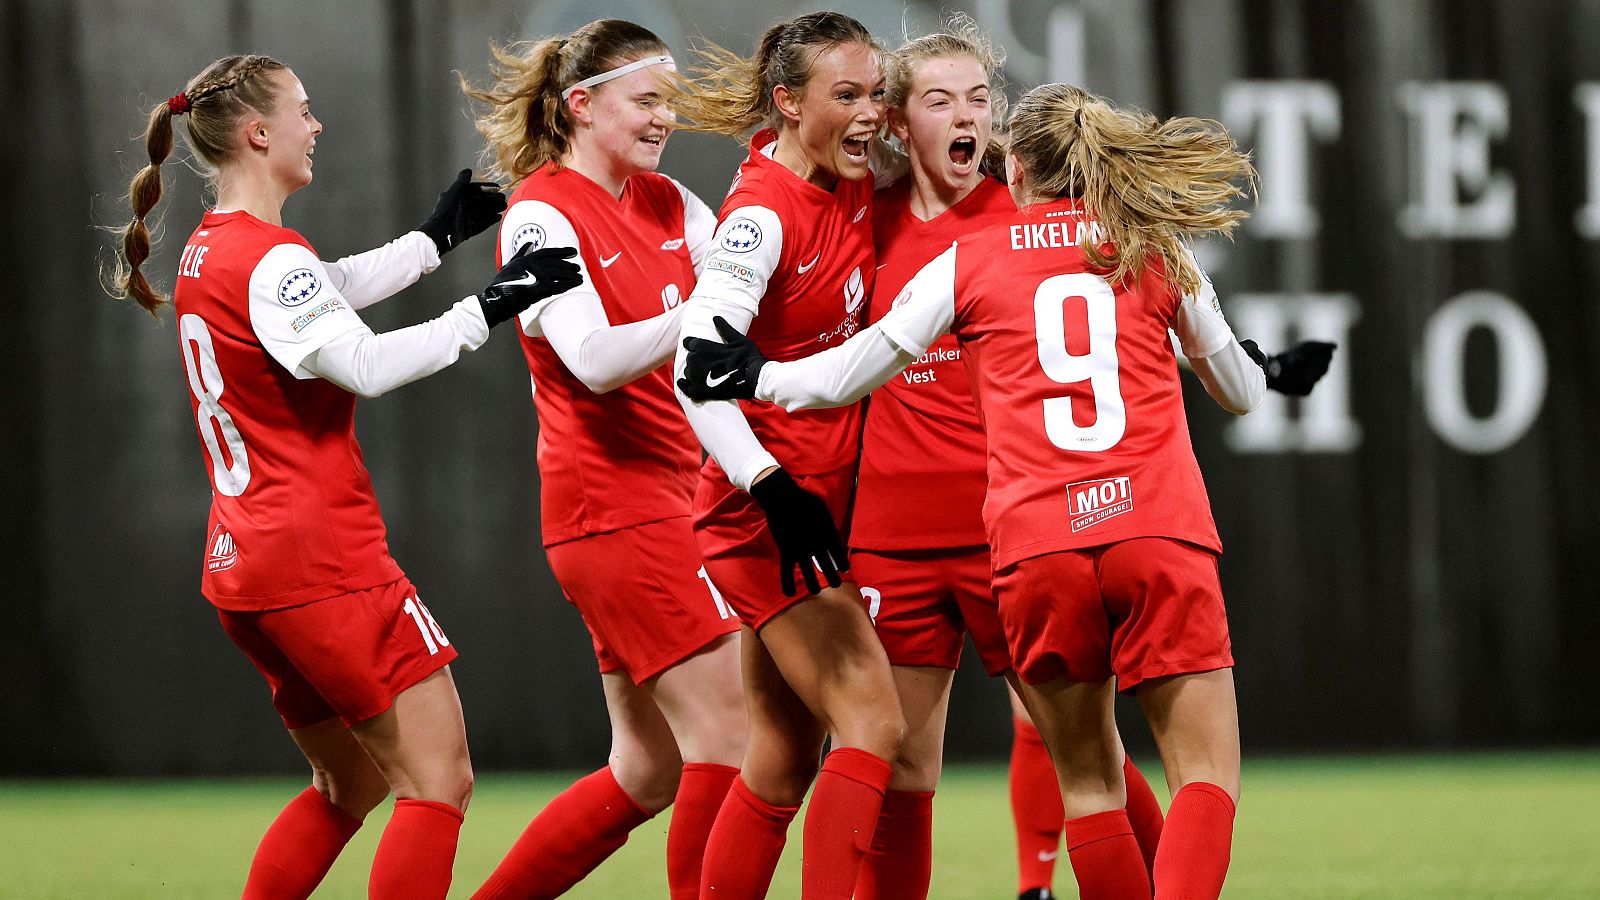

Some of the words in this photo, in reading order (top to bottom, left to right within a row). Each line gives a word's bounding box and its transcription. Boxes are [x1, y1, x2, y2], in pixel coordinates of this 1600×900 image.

[1222, 80, 1600, 239] TE
[1009, 220, 1109, 250] EIKELAN
[292, 299, 342, 332] FOUNDATIO
[902, 368, 937, 385] Vest
[1033, 272, 1127, 452] 9
[1076, 476, 1131, 514] MOT
[1076, 515, 1094, 528] SHOW
[696, 563, 738, 620] 1
[403, 593, 450, 656] 18
